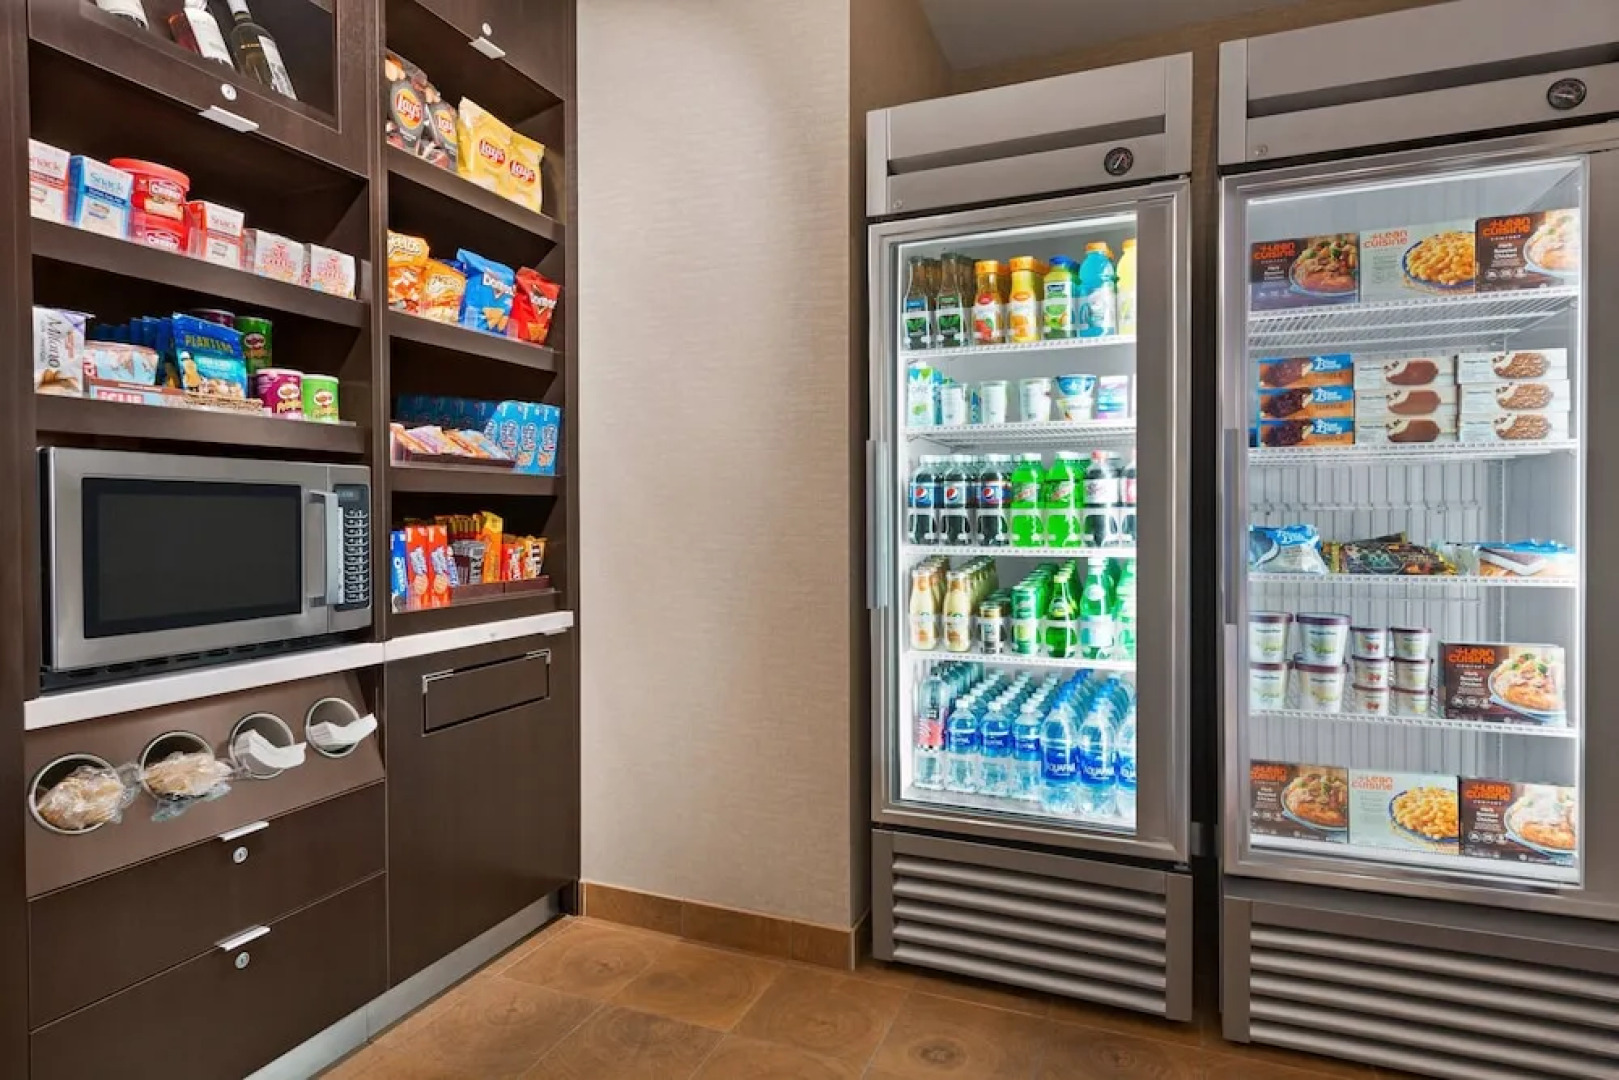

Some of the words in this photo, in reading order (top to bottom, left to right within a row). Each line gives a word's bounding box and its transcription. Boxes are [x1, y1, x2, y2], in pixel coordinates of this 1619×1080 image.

[395, 93, 422, 121] Lay's
[480, 140, 505, 164] Lay's
[510, 160, 534, 184] Lay's
[47, 316, 62, 368] Milano
